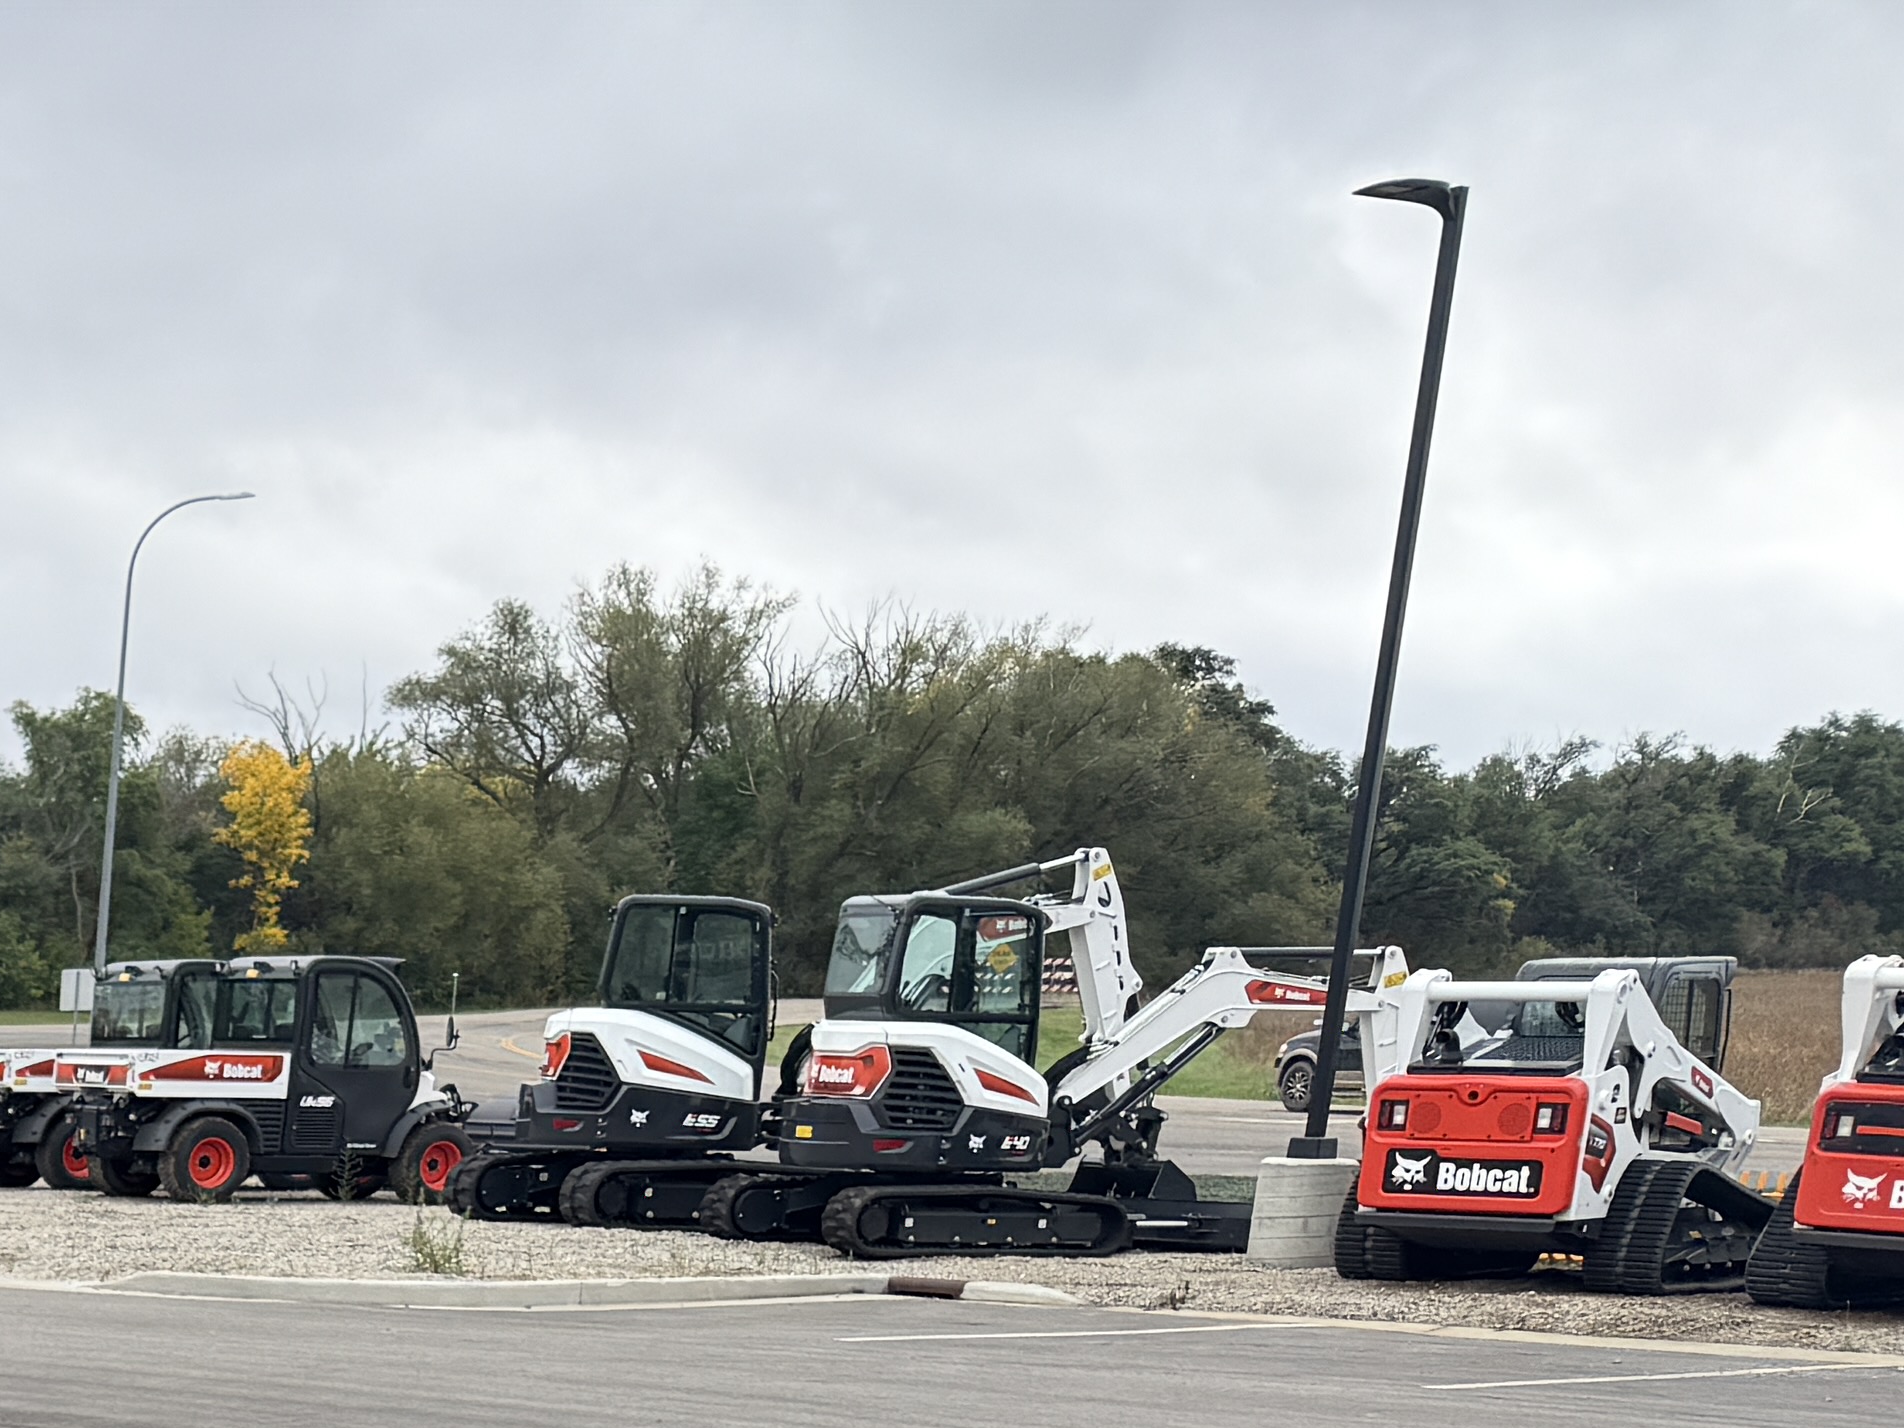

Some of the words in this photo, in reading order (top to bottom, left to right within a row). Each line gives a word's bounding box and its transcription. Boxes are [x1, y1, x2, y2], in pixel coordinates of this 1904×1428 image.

[223, 1062, 263, 1078] Bobcat
[818, 1064, 854, 1083] Bobcat
[1436, 1162, 1531, 1194] Bobcat
